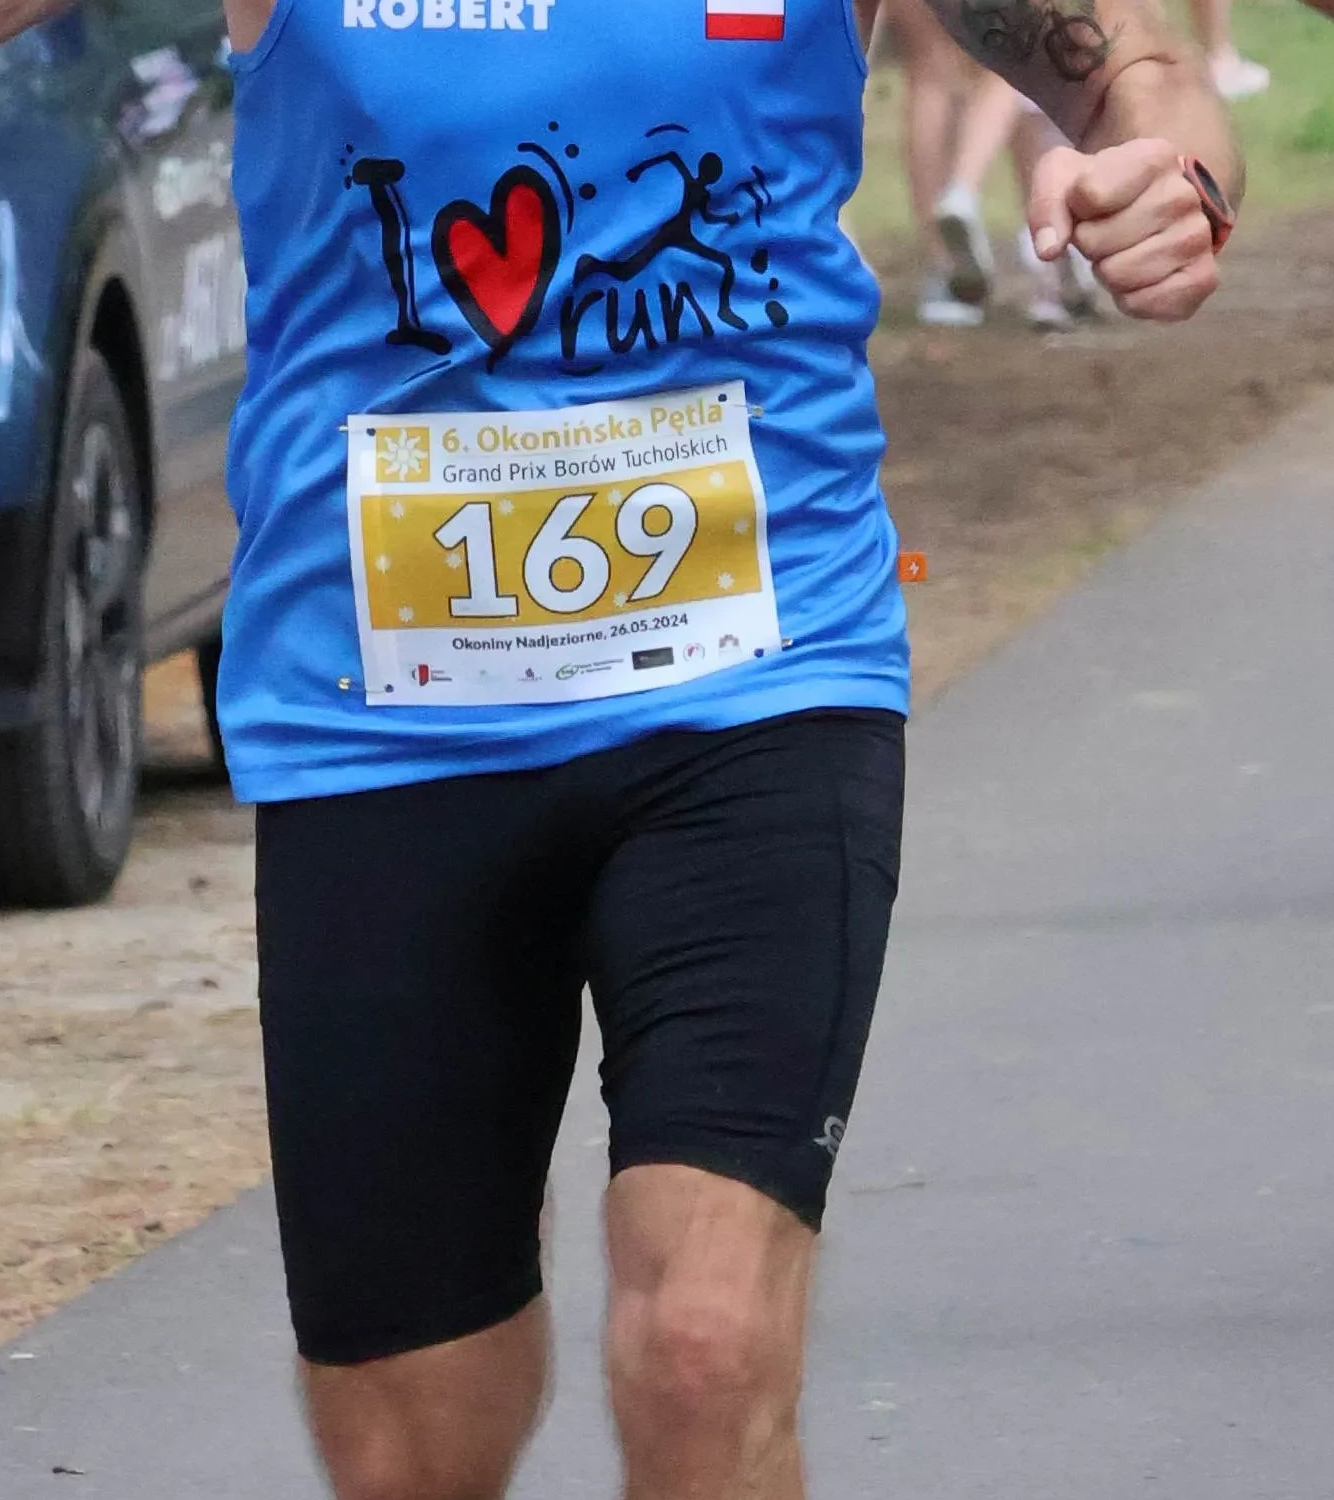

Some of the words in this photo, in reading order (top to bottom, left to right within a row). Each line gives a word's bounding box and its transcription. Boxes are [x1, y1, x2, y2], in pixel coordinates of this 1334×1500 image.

[441, 427, 468, 453] 6.
[476, 414, 643, 452] Okonińska
[649, 396, 724, 437] Pętla
[442, 464, 502, 483] Grand
[509, 462, 547, 481] Prix
[554, 454, 616, 478] Borów
[622, 434, 728, 467] Tucholskich
[432, 482, 699, 619] 169
[451, 636, 513, 652] Okoniny
[516, 630, 608, 650] Nadjeziorne,
[610, 613, 689, 638] 26.05.2024
